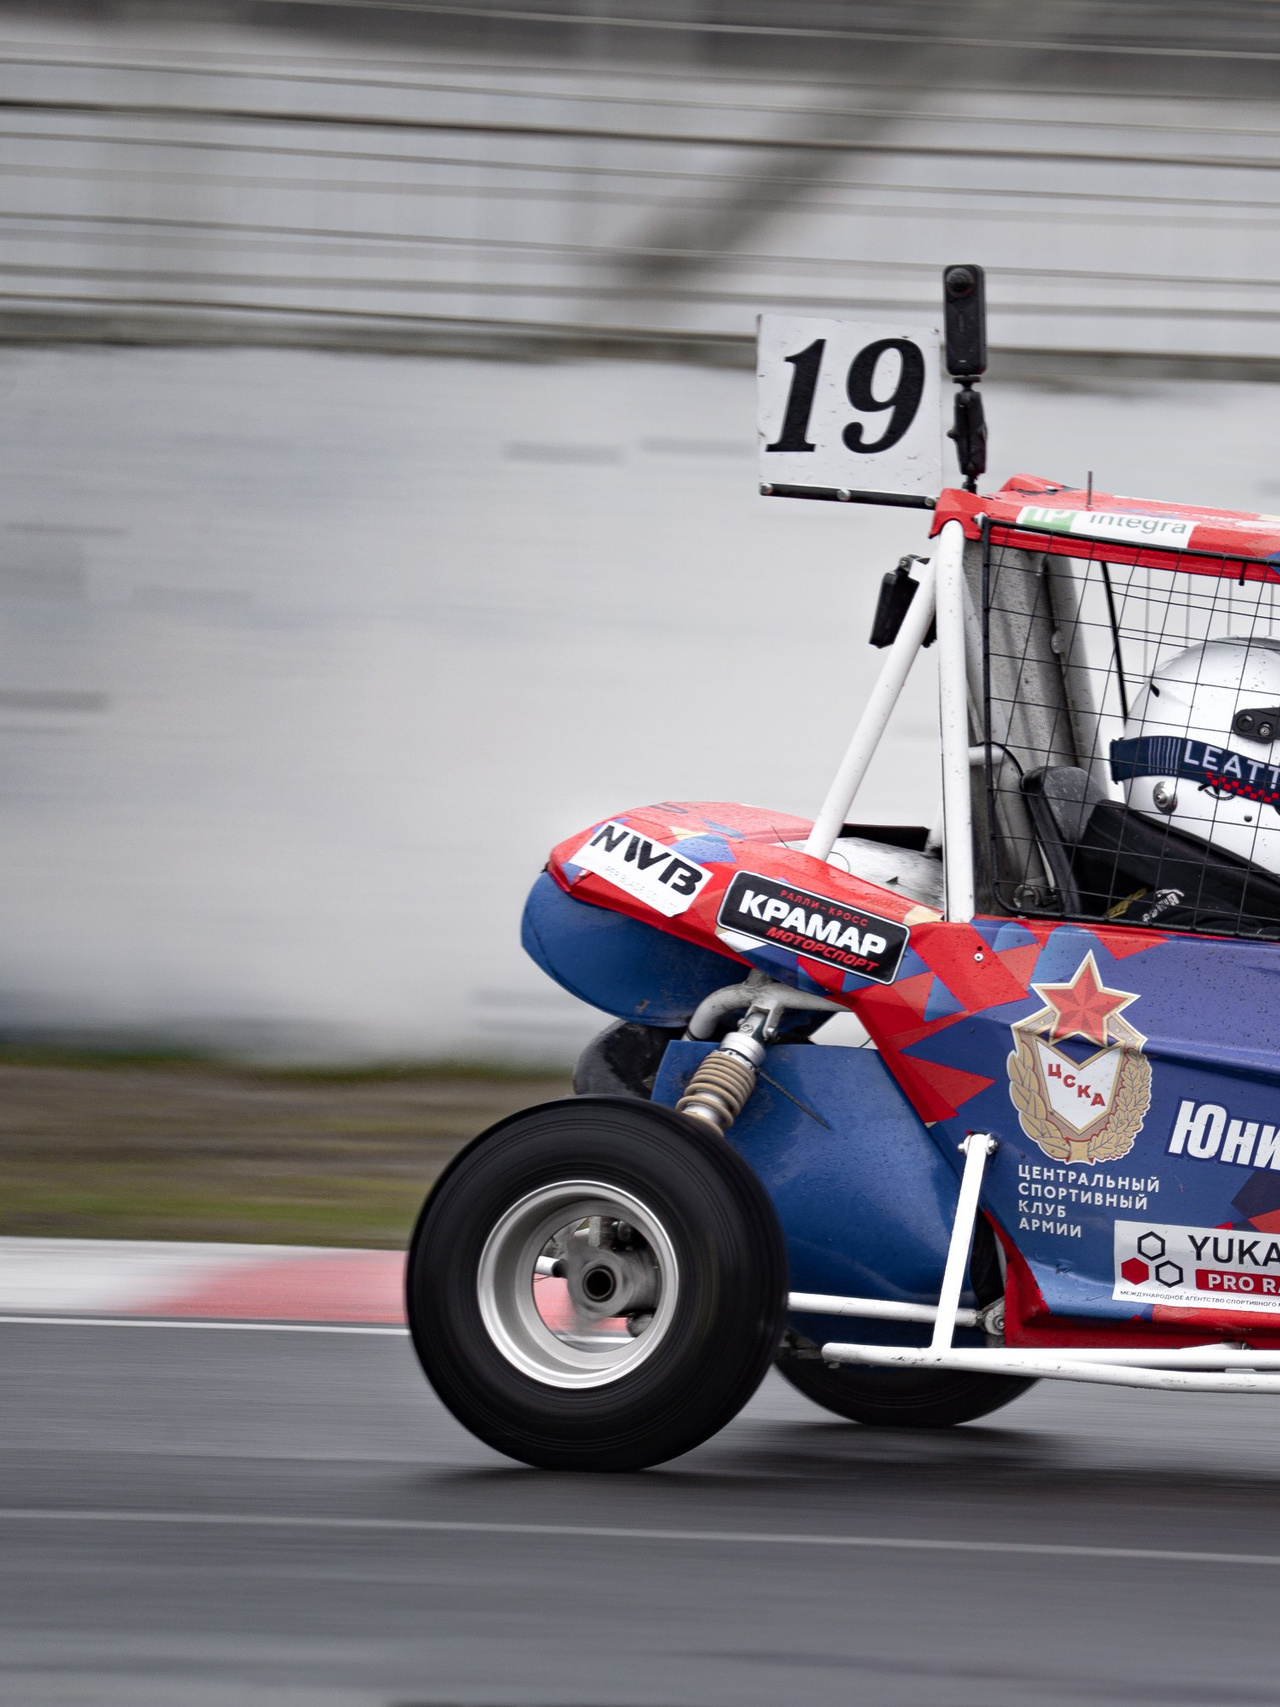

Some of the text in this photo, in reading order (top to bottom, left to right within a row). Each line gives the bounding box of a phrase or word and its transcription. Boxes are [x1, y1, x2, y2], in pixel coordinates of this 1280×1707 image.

[766, 338, 926, 454] 19
[1089, 513, 1188, 535] integra
[738, 889, 887, 957] КРАМАР
[765, 926, 880, 972] МОТОРСПОРТ
[1047, 1063, 1107, 1108] ЦСКА
[1018, 1164, 1160, 1193] ЦЕНТРАЛЬНЫЙ
[1018, 1182, 1148, 1211] СПОРТИВНЫЙ
[1018, 1199, 1067, 1218] КЛУБ
[1019, 1217, 1082, 1238] АРМИИ
[1207, 1274, 1255, 1292] PRO
[1120, 1290, 1184, 1301] МЕЖДУНАРОДНОЕ
[1185, 1295, 1225, 1304] АГЕНТСТВО
[1226, 1298, 1277, 1308] СПОРТИВНОГО
